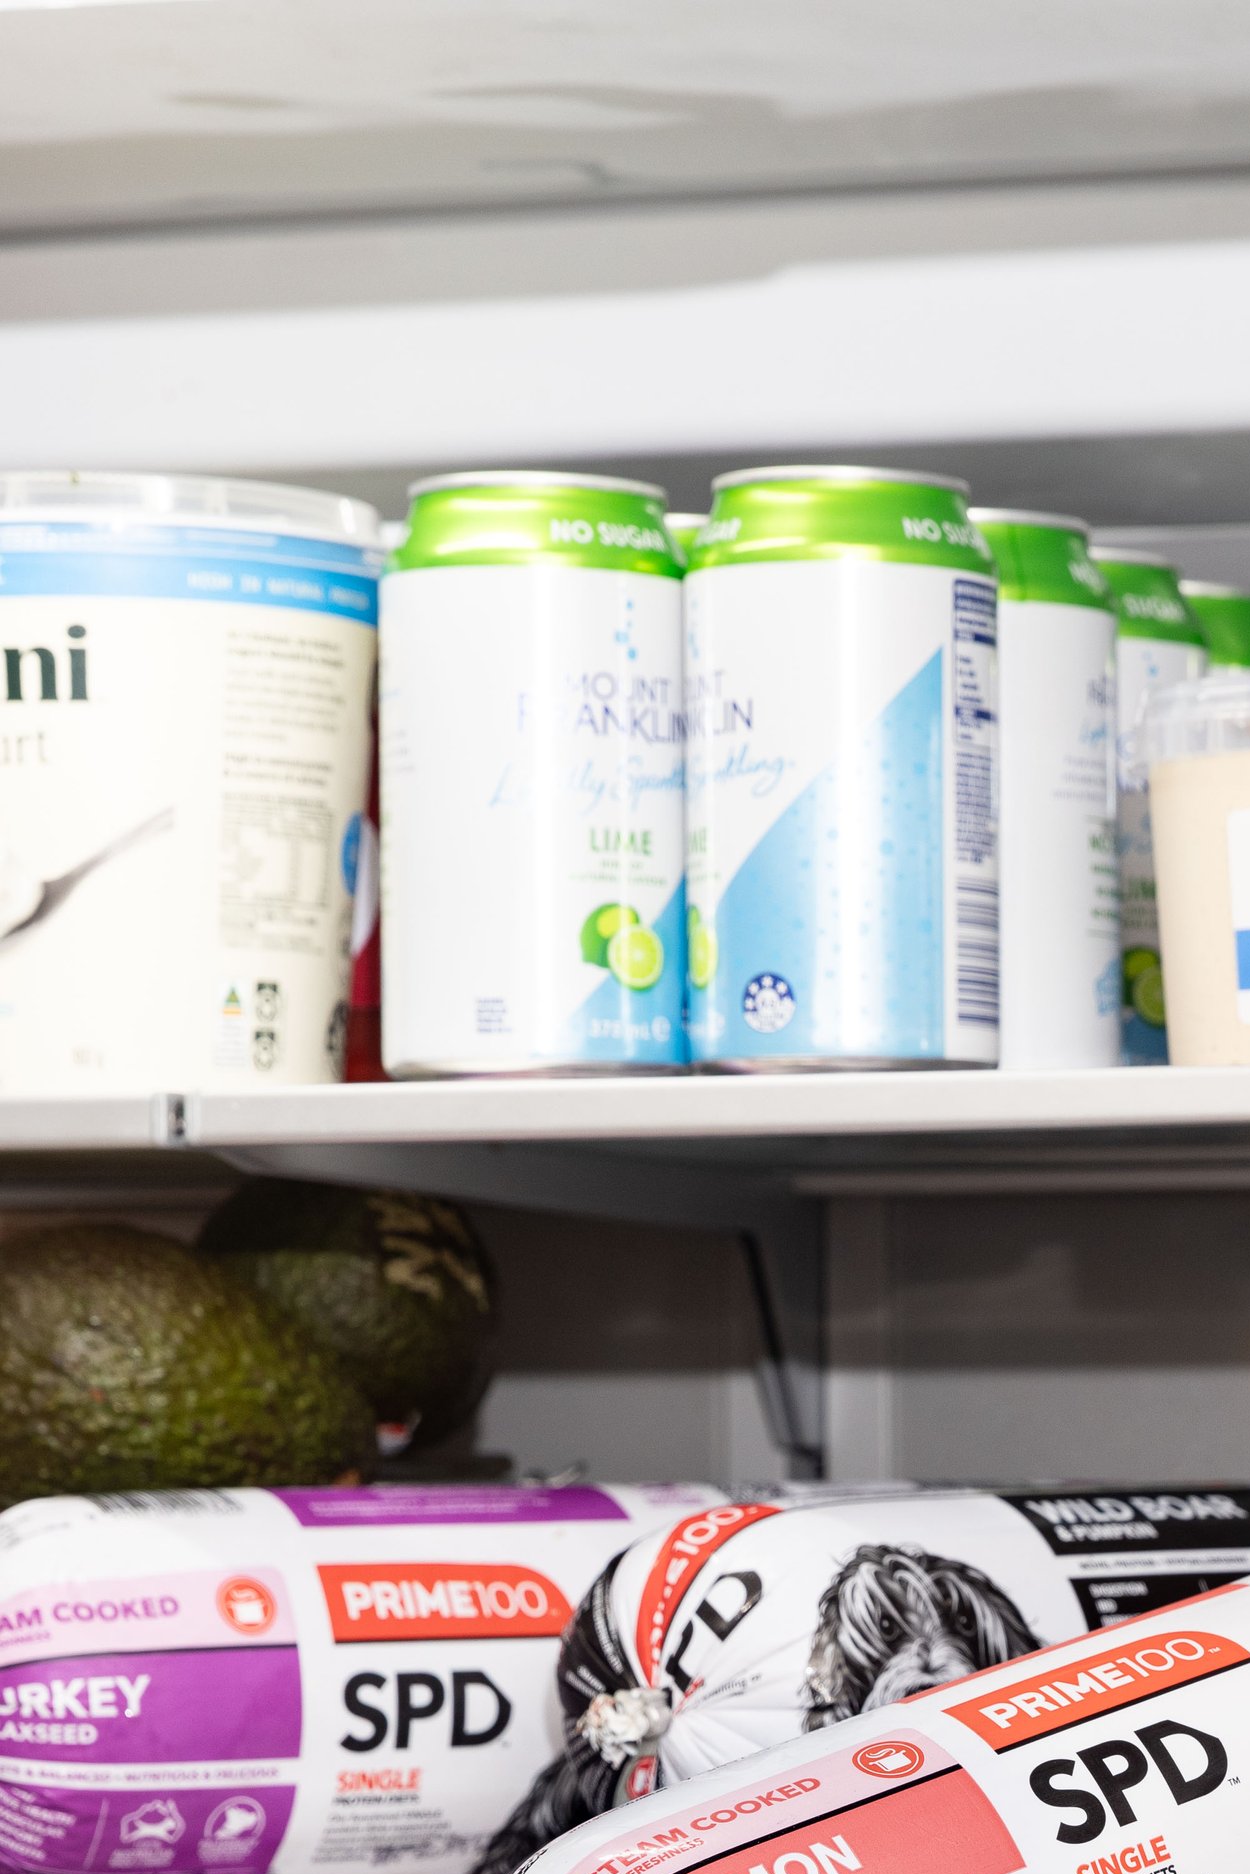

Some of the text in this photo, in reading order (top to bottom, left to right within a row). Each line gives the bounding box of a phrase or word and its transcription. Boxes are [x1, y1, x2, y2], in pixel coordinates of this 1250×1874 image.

[551, 519, 595, 544] NO
[902, 517, 942, 542] NO
[590, 828, 653, 856] LIME
[1026, 1493, 1248, 1525] WILD BOAR
[53, 1596, 180, 1623] COOKED
[340, 1580, 549, 1620] PRIME100
[979, 1638, 1205, 1729] PRIME100
[340, 1672, 513, 1752] SPD
[336, 1768, 423, 1792] SINGLE
[1029, 1720, 1228, 1844] SPD
[690, 1777, 821, 1832] COOKED
